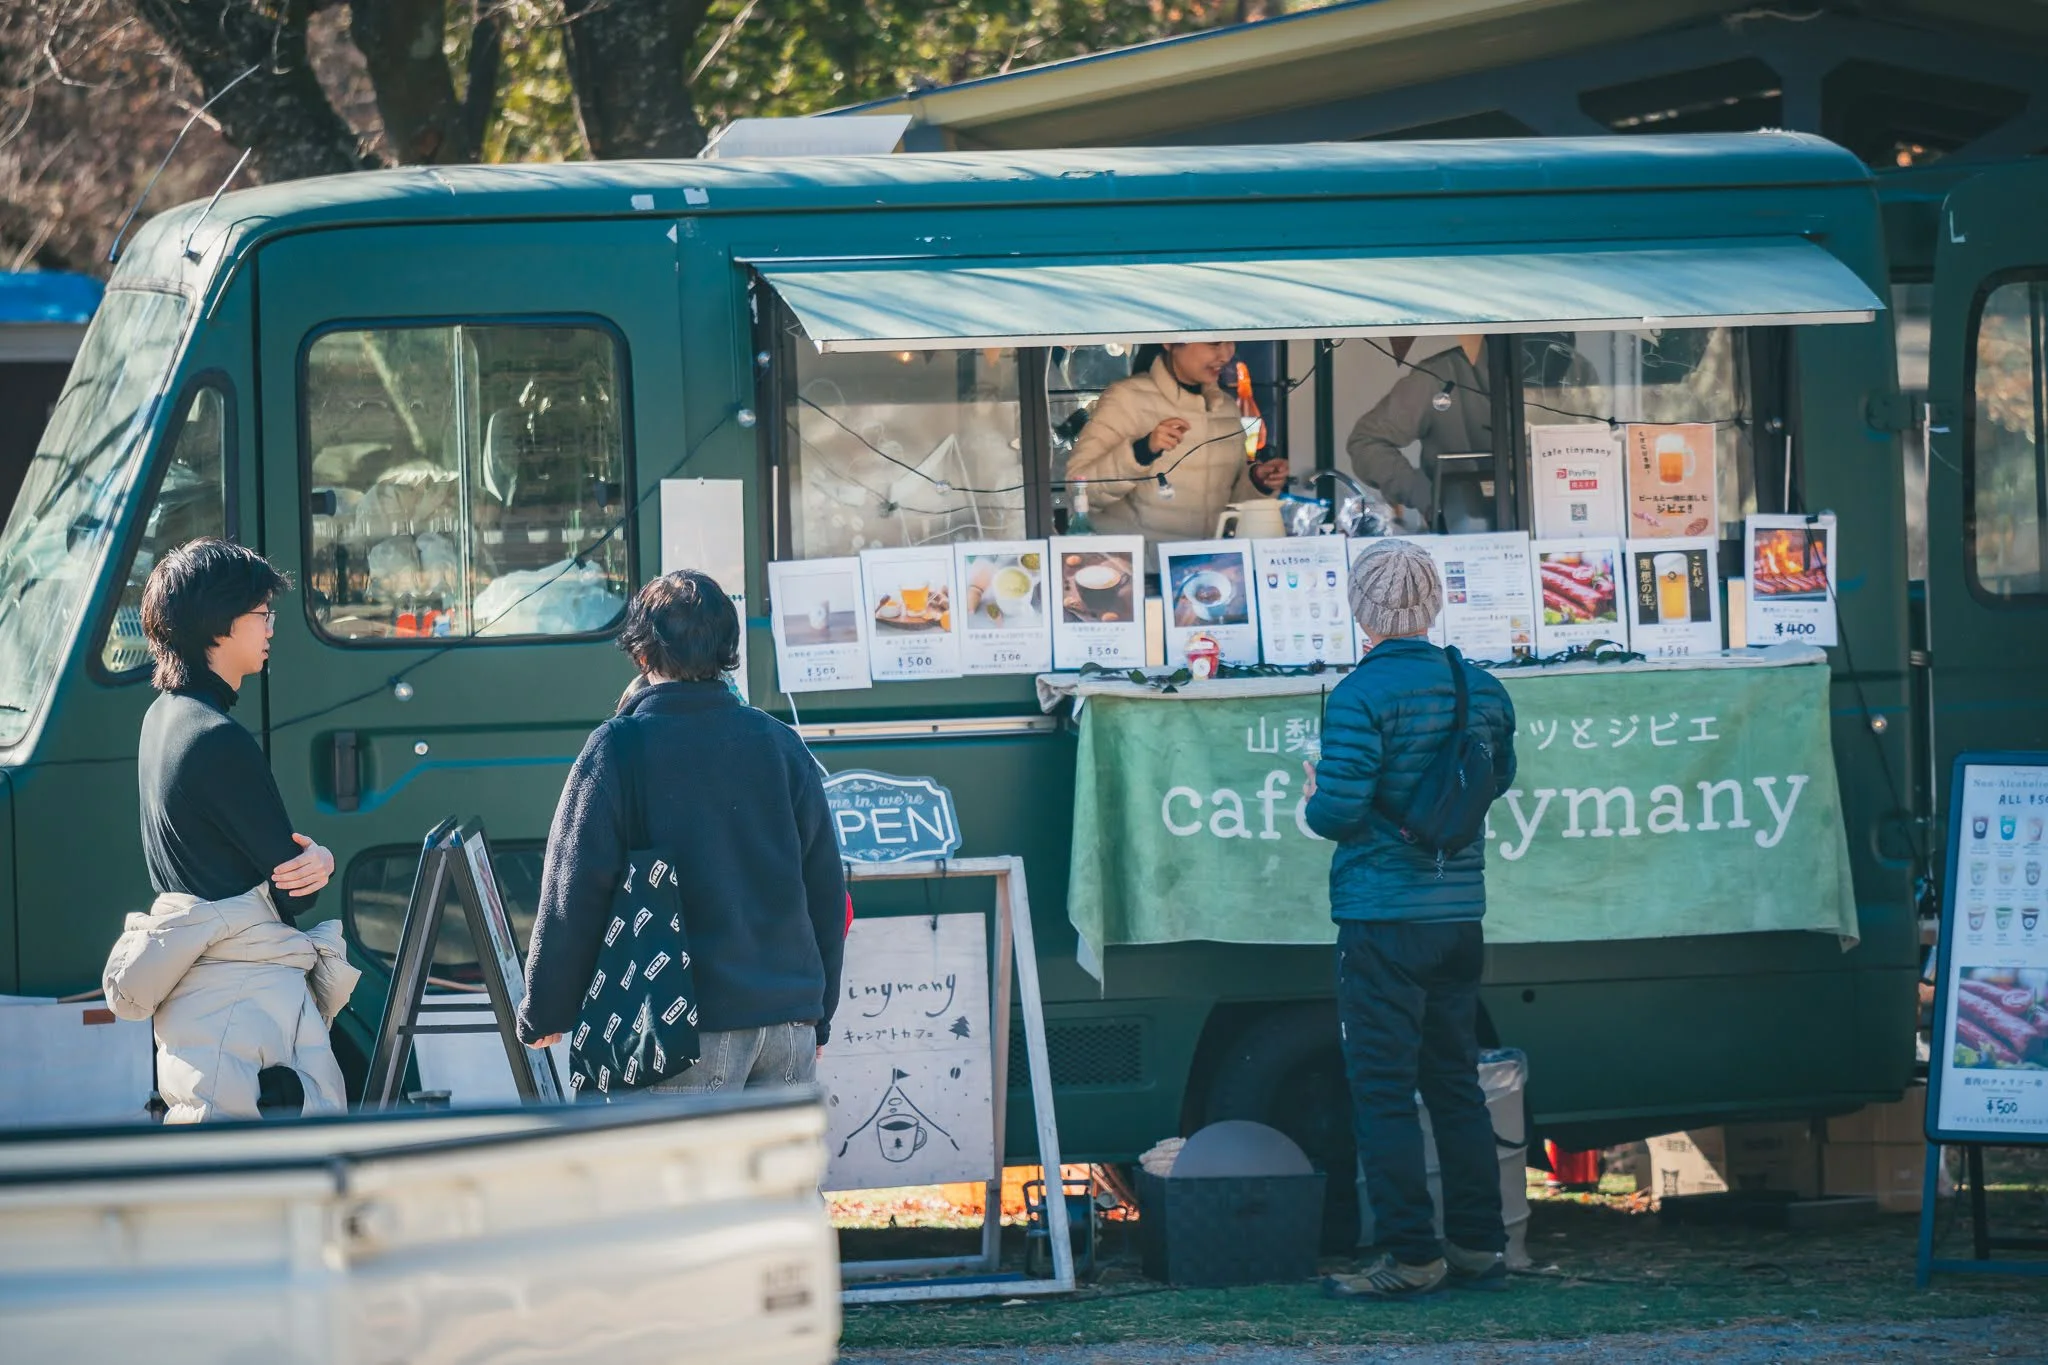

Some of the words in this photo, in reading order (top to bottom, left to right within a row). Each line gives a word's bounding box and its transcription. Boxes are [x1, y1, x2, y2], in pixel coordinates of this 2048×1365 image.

[1541, 448, 1562, 458] cafe
[1566, 447, 1612, 457] tinymany
[1774, 622, 1816, 637] ¥400
[993, 653, 1021, 662] ¥500
[1087, 646, 1120, 657] ¥500
[898, 656, 933, 668] ¥500
[807, 667, 836, 677] ¥500
[1514, 712, 1720, 750] ツとジビエ
[878, 790, 925, 806] we're
[1998, 794, 2022, 805] ALL
[606, 920, 623, 943] IKEA
[647, 955, 667, 978] IKEA
[666, 1000, 686, 1022] IKEA
[575, 1025, 588, 1048] IKEA
[627, 1059, 636, 1082] IKEA
[1986, 1099, 2018, 1114] ¥500
